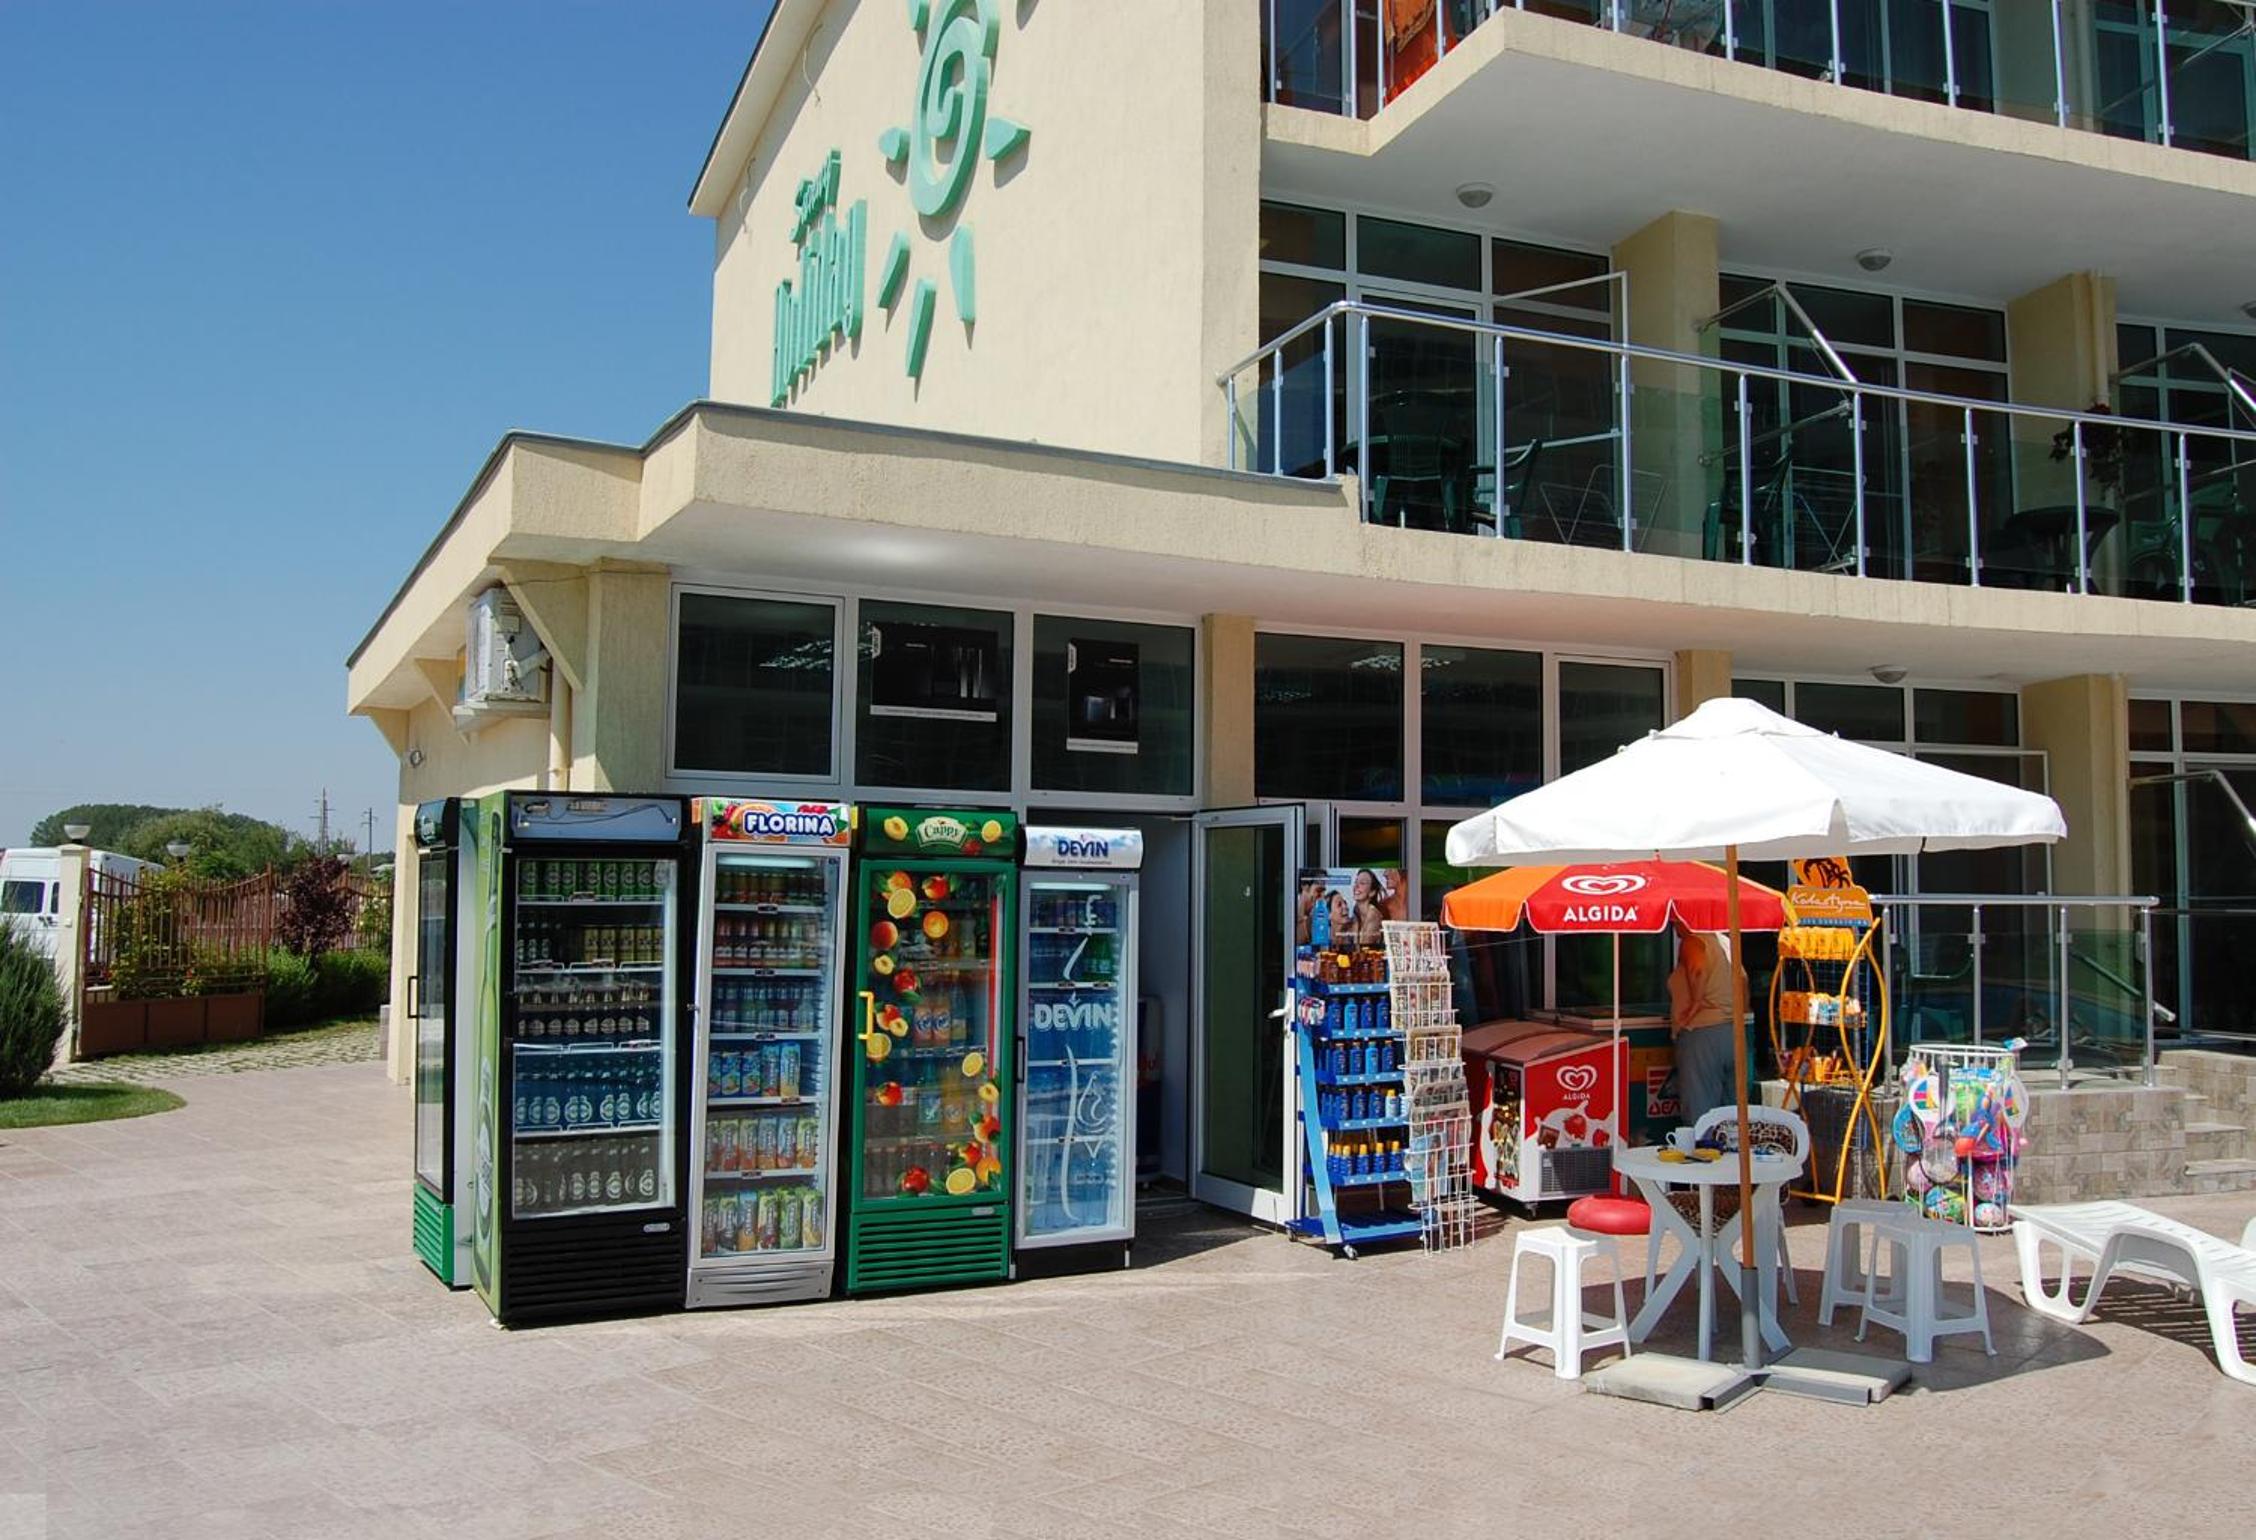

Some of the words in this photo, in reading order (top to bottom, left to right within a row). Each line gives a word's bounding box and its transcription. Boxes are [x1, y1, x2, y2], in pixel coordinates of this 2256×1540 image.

[745, 813, 835, 836] FLORINA
[923, 823, 961, 839] Cappy
[1058, 840, 1108, 856] DEVIN
[1563, 906, 1638, 922] ALGIDA
[1034, 1003, 1112, 1031] DEVIN
[1562, 1093, 1591, 1101] ALGIDA
